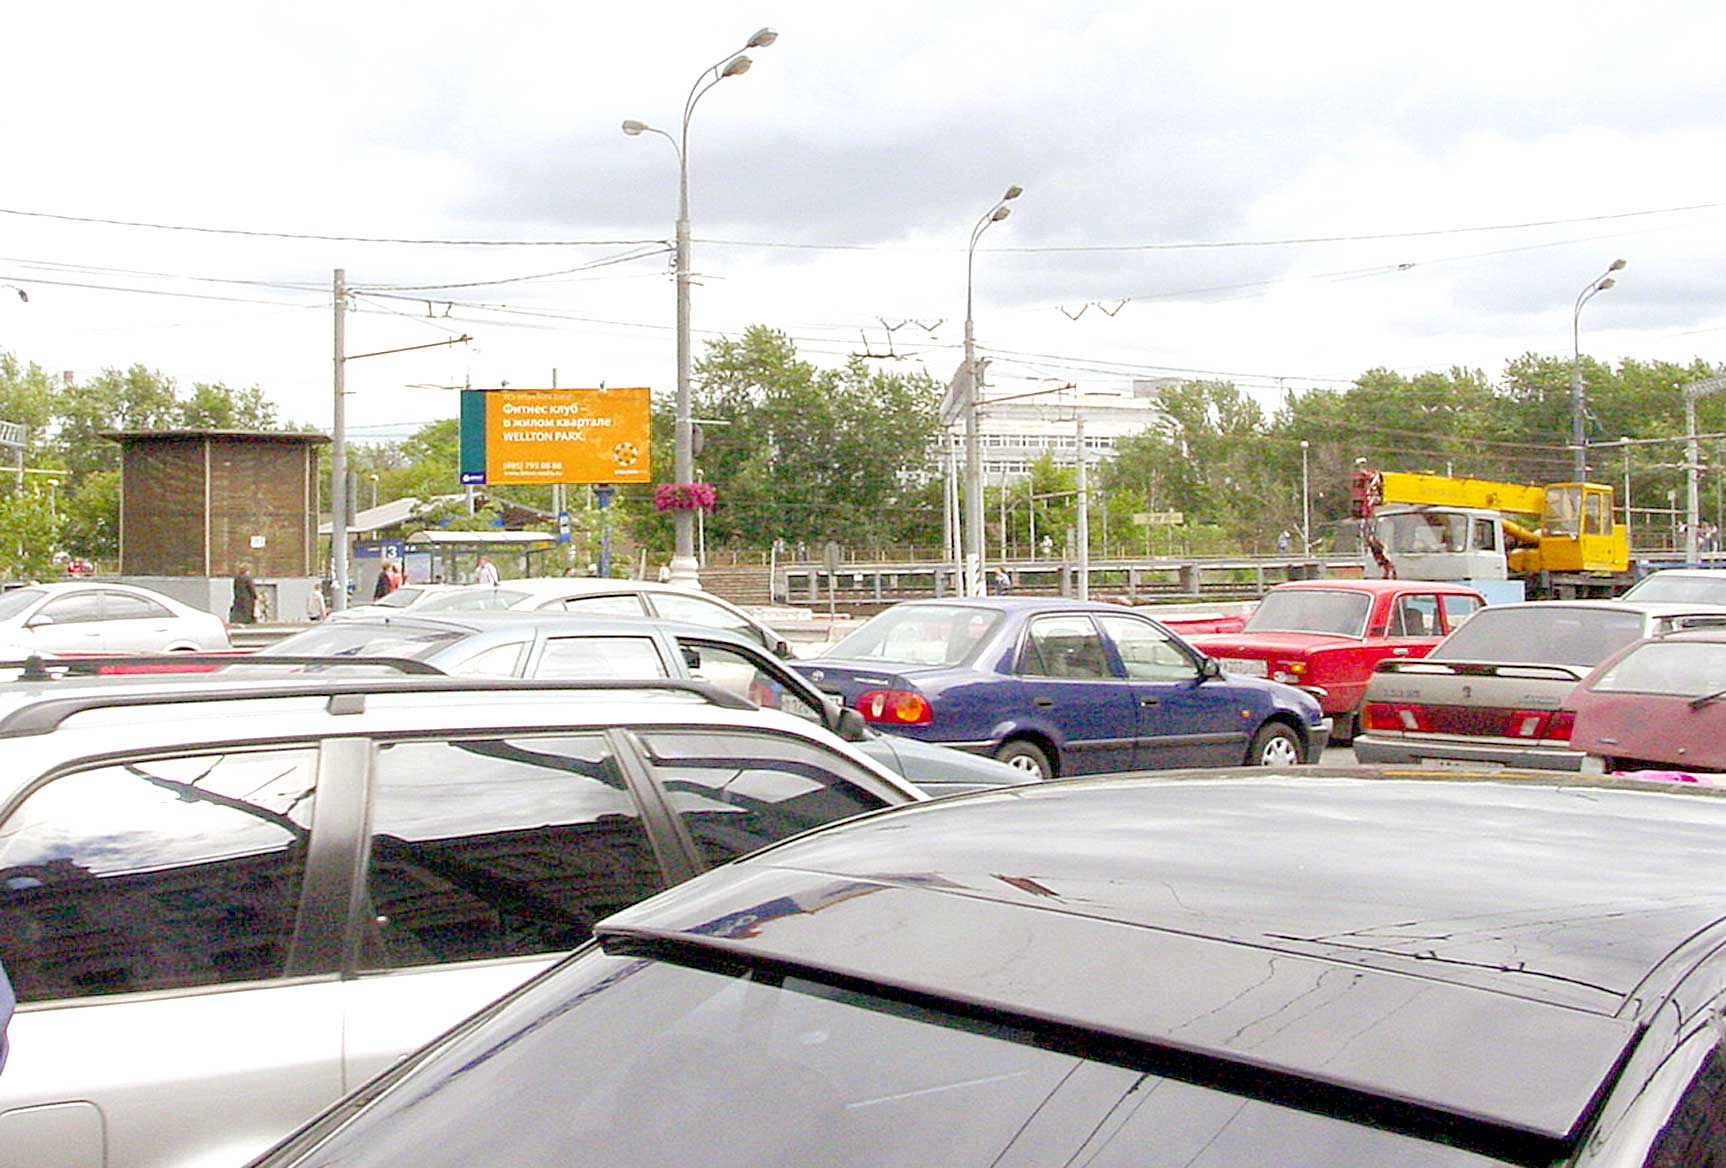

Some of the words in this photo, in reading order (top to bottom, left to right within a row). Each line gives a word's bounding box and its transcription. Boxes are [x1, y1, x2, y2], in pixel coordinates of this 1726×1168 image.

[503, 403, 547, 414] Фитнес
[549, 402, 579, 416] клуб
[503, 418, 511, 427] в
[513, 418, 554, 427] жилом
[556, 417, 612, 429] квартале
[503, 431, 553, 441] WELLTON
[387, 545, 397, 558] 3
